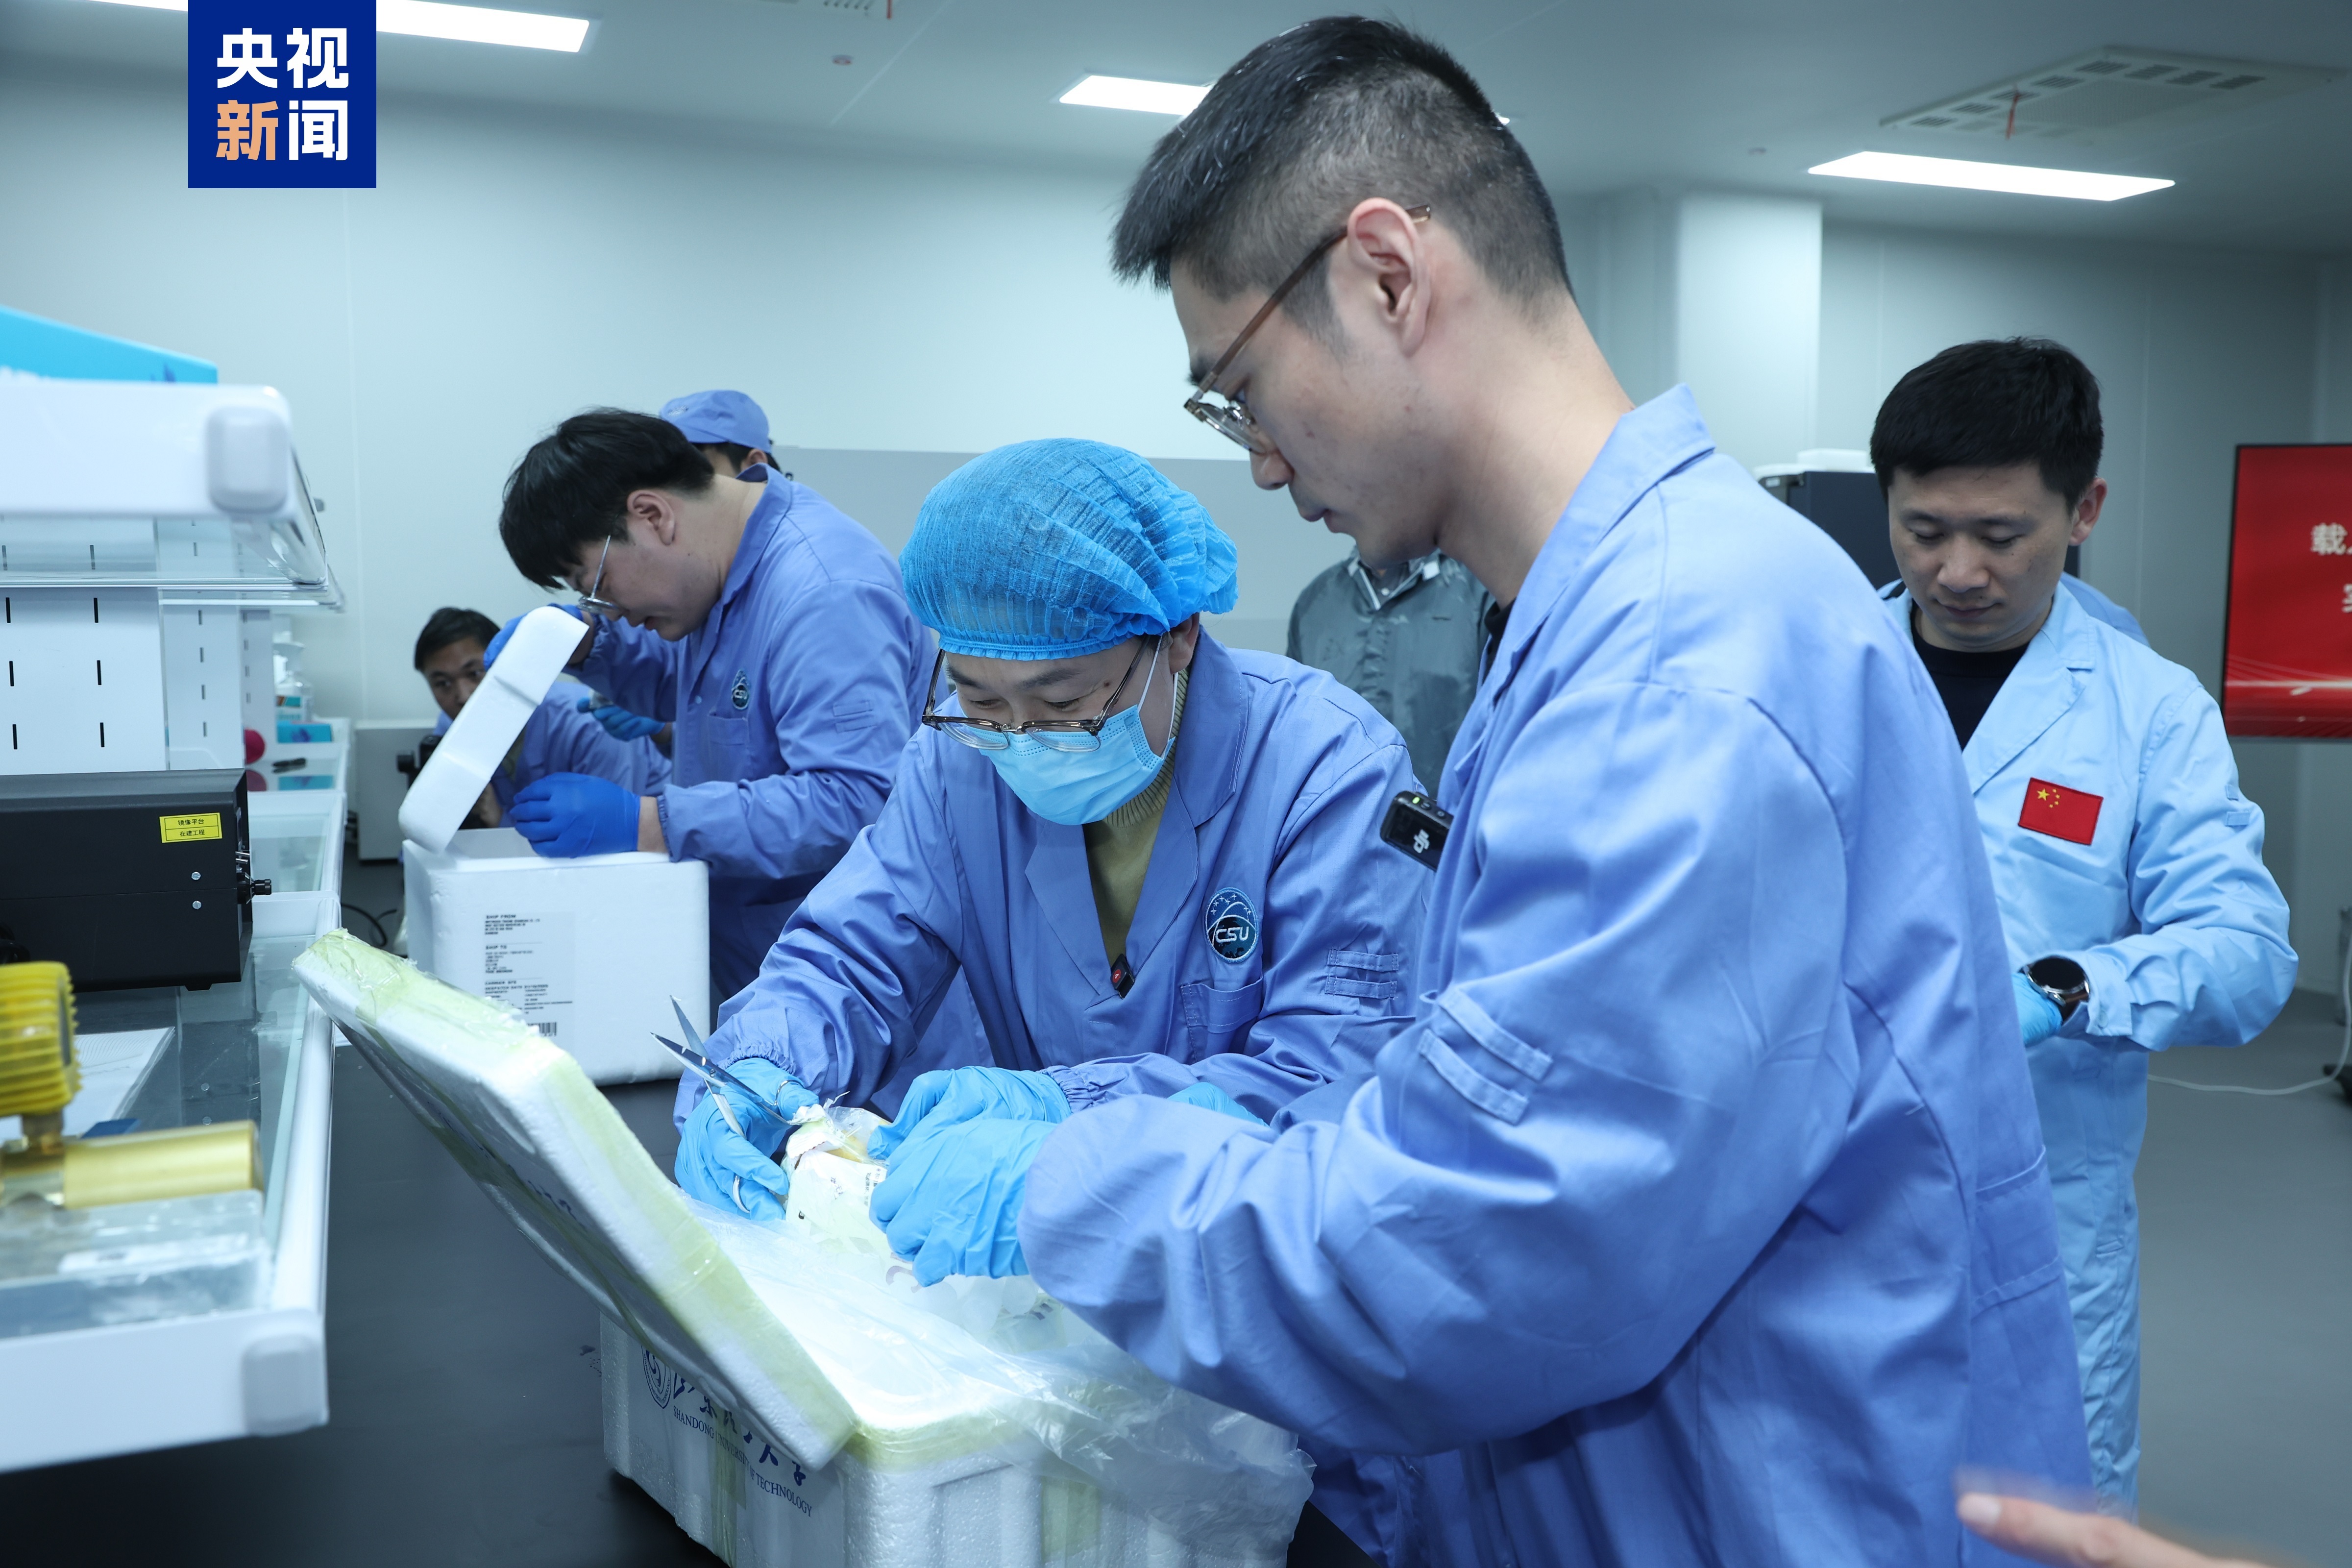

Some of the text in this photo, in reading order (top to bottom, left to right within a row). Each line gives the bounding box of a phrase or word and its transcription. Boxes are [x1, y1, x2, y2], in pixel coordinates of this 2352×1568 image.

[2310, 522, 2352, 556] 载
[1215, 926, 1250, 943] CSU
[673, 1405, 714, 1439] SHANDONG
[756, 1473, 812, 1517] TECHNOLOGY
